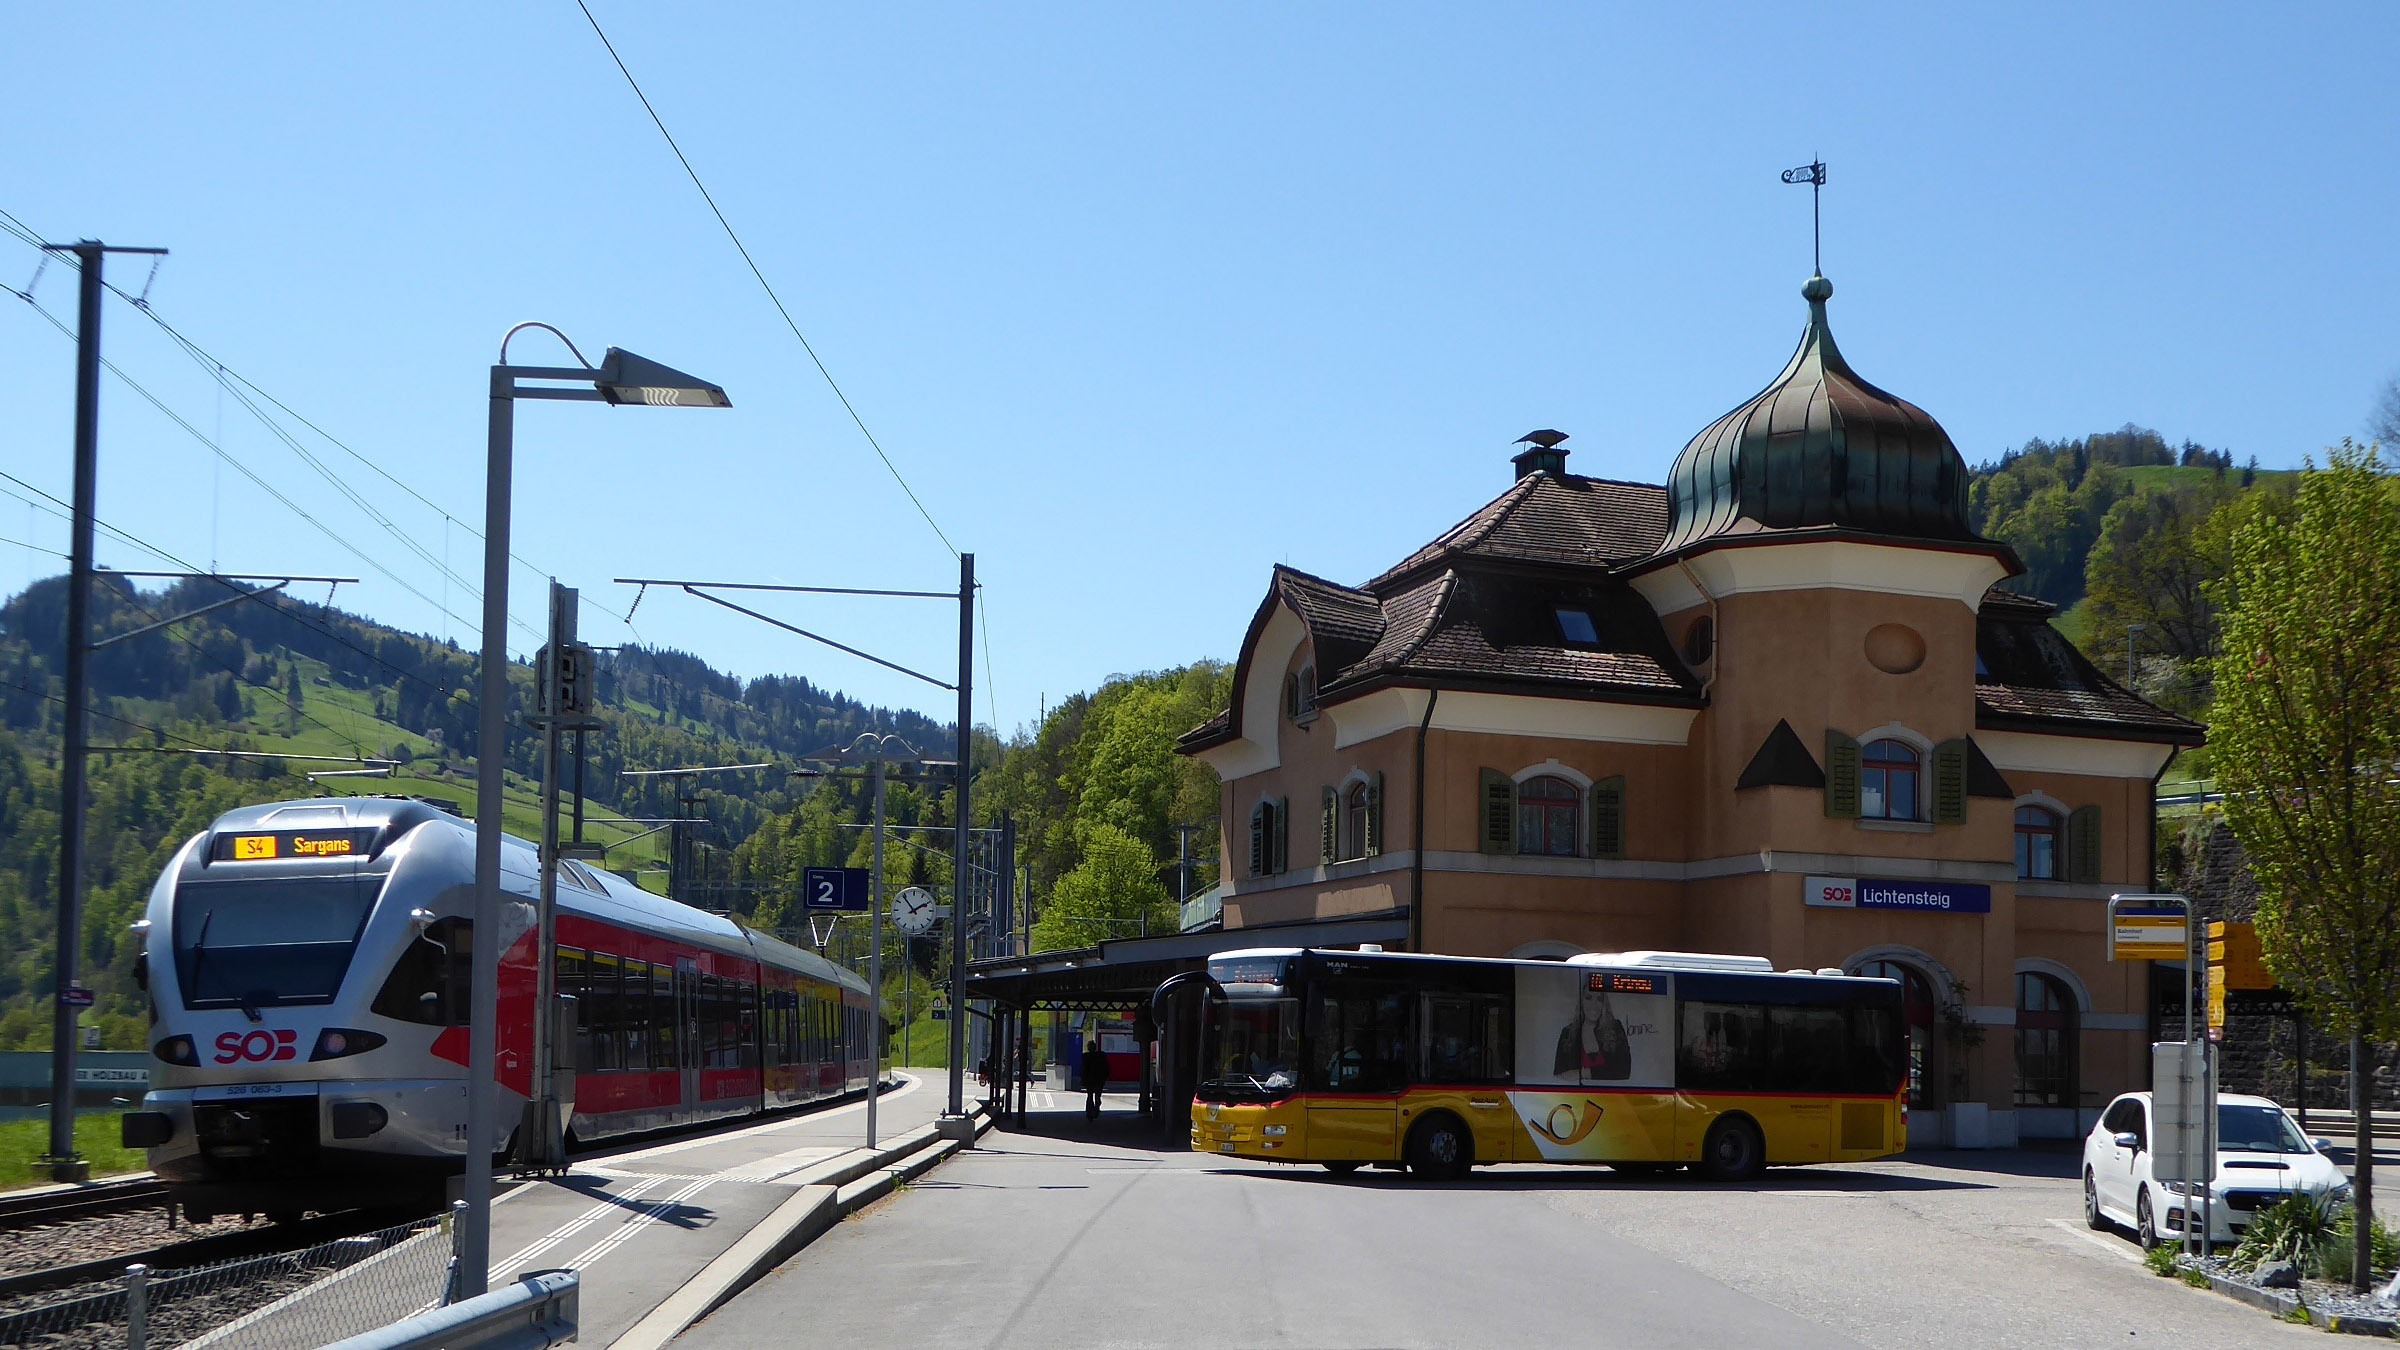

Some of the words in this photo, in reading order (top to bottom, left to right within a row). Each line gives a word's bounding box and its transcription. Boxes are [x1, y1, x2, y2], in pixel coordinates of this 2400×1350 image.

[247, 839, 264, 854] S4
[294, 836, 350, 855] Sargans
[818, 881, 834, 902] 2
[1823, 886, 1853, 902] SOB
[1863, 888, 1951, 909] Lichtensteig
[213, 1028, 298, 1065] SOB
